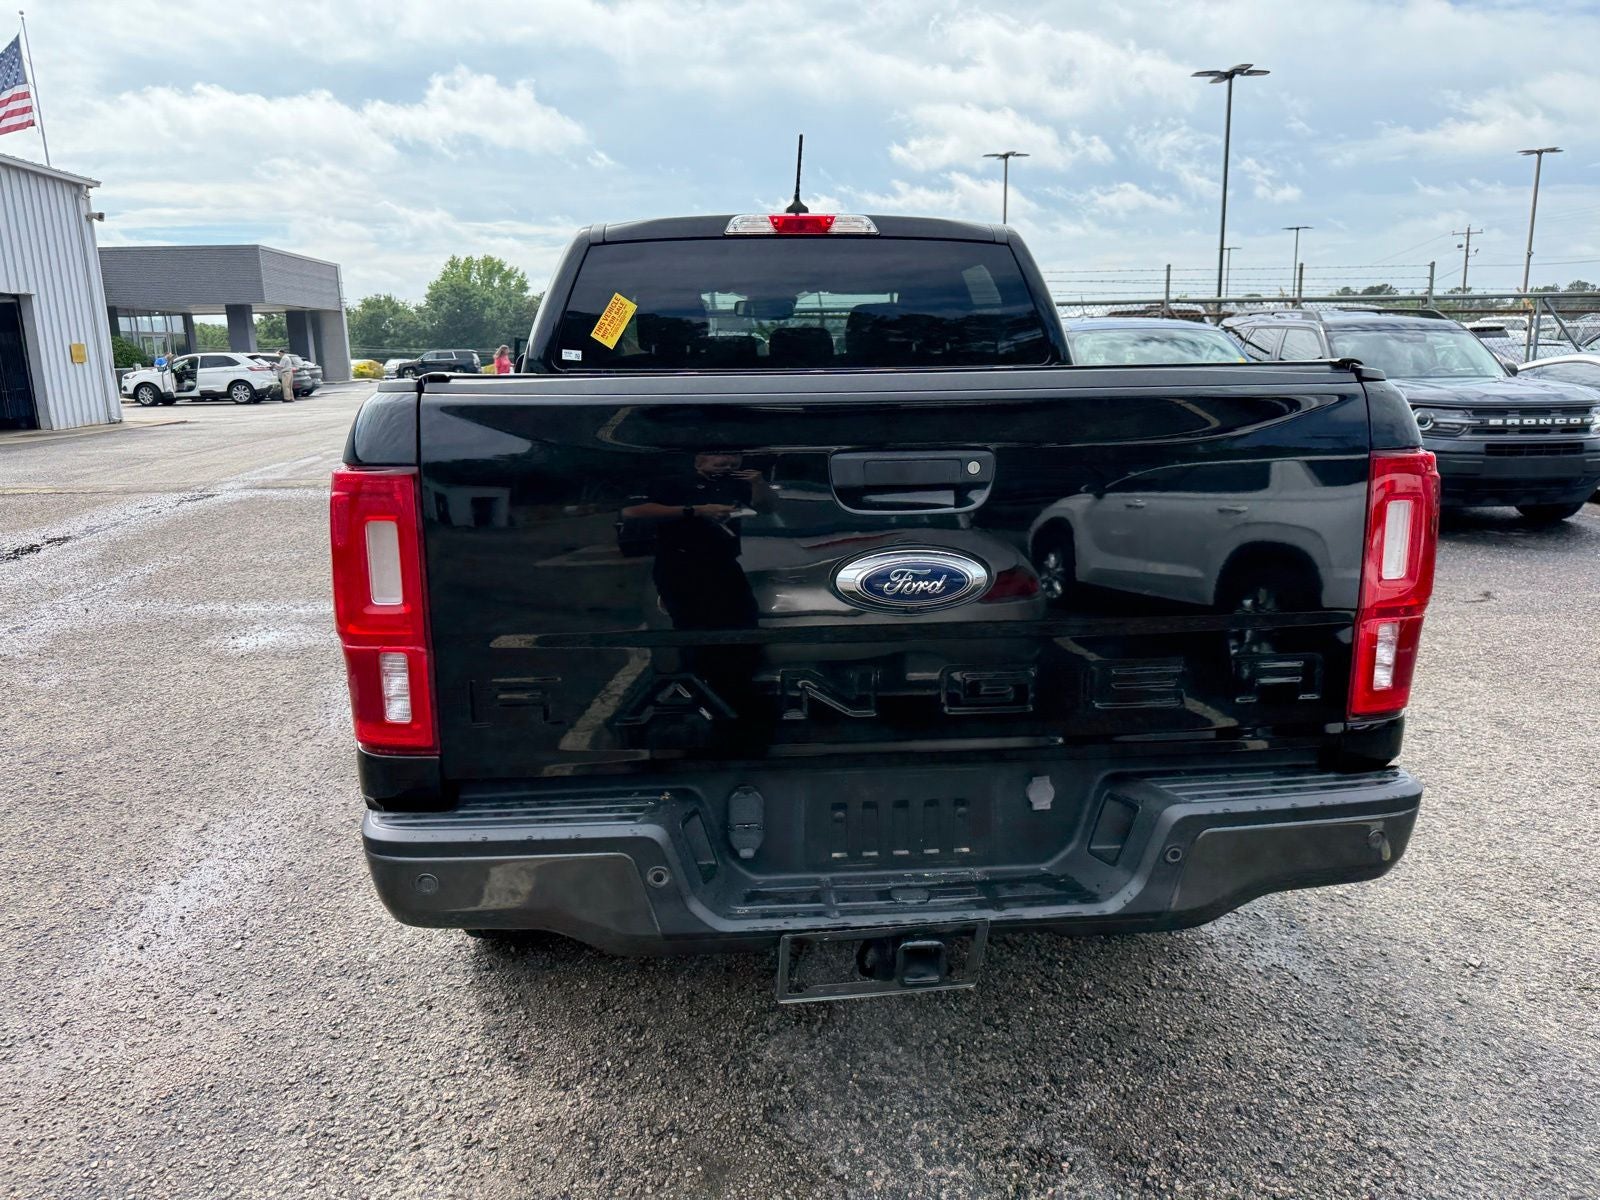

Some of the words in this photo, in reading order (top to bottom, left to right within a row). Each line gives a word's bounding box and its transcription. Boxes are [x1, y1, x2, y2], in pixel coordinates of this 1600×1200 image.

[594, 321, 606, 336] THIS
[602, 296, 620, 321] VEHICLE
[601, 327, 610, 338] NOT
[607, 315, 617, 327] FOR
[614, 302, 624, 315] SALE
[1488, 417, 1582, 426] BRONCO
[883, 568, 947, 595] Ford
[467, 653, 1323, 728] RANGER
